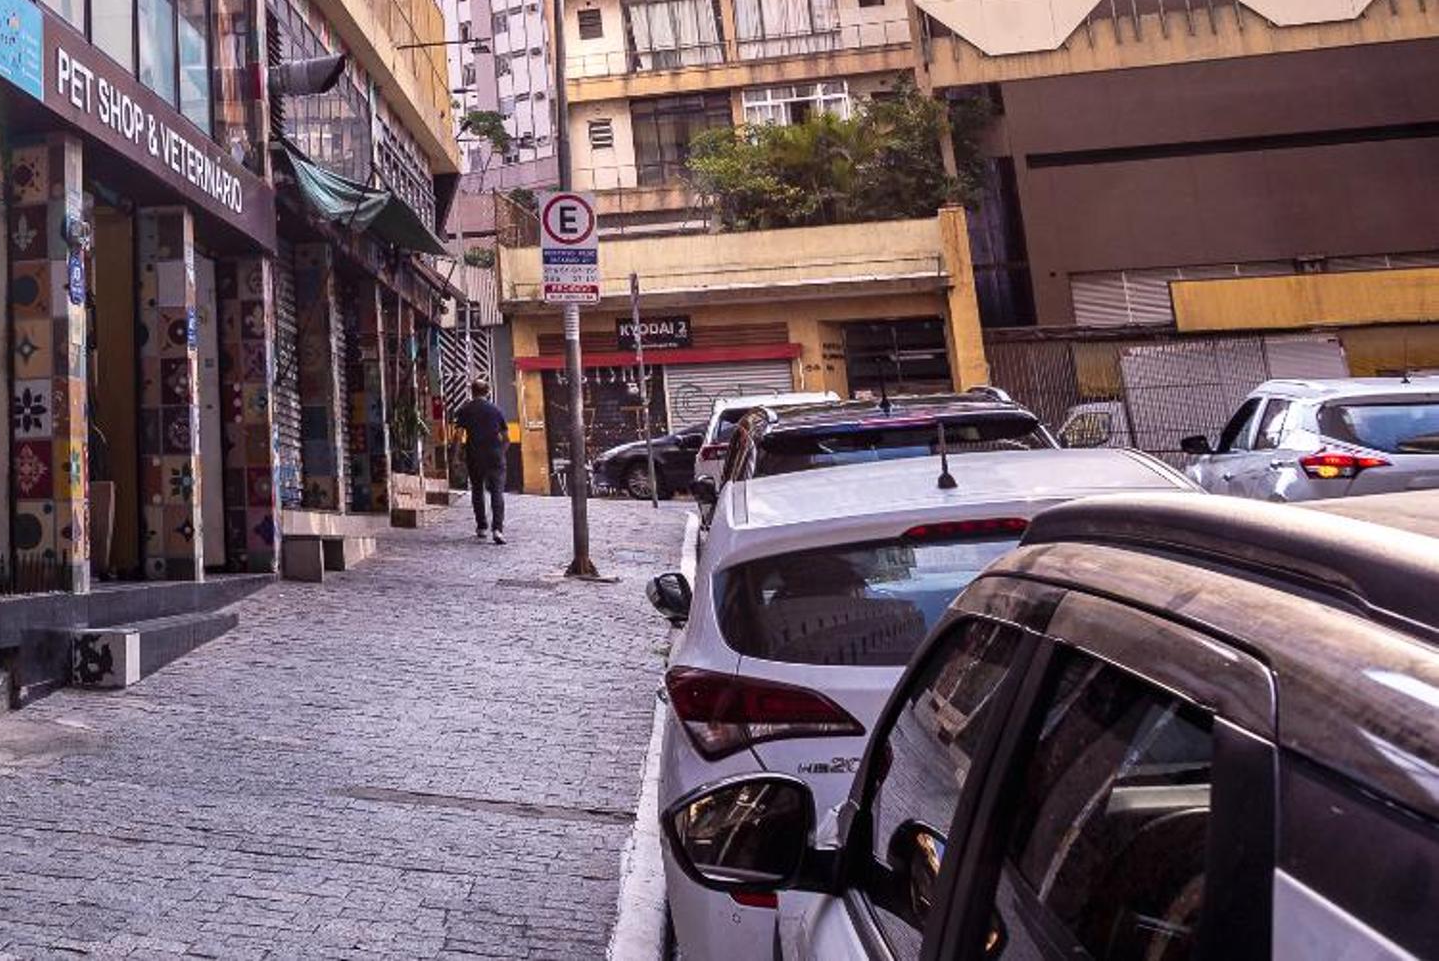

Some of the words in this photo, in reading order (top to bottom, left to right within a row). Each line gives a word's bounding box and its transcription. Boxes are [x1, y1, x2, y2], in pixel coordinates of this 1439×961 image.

[58, 45, 95, 115] PET
[97, 77, 145, 146] SHOP
[145, 113, 160, 158] &
[160, 121, 242, 214] VETERINÁRIO
[559, 205, 578, 234] E
